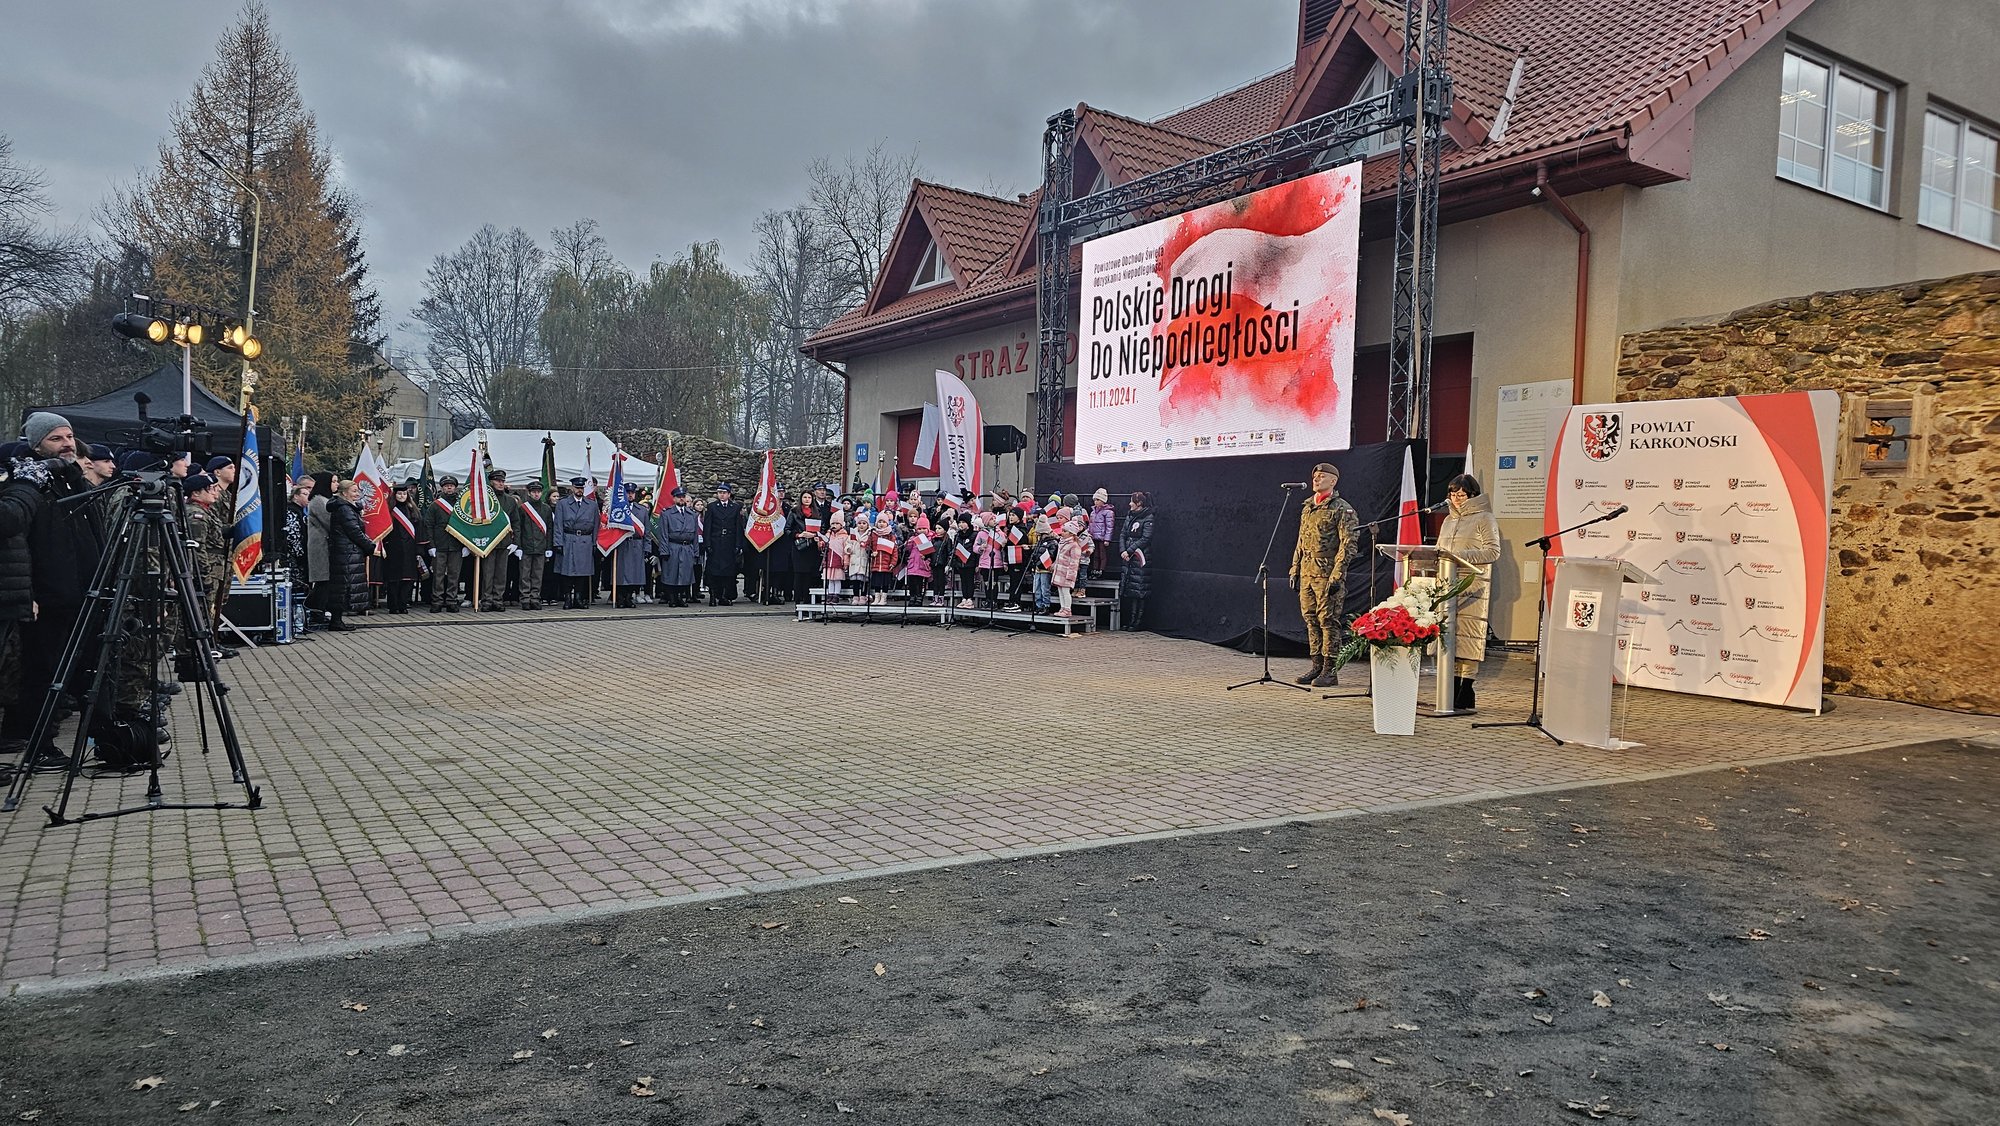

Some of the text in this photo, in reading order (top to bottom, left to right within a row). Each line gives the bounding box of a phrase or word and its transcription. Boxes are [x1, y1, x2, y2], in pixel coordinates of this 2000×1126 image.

[1092, 261, 1233, 335] Polskie Drogi
[954, 332, 1029, 380] STRAŻ
[1090, 341, 1111, 380] Do
[1118, 300, 1299, 378] Niepodległości
[1089, 387, 1139, 408] 11.11.2024 r.
[1629, 435, 1738, 450] KARKONOSKI
[1630, 420, 1695, 434] POWIAT
